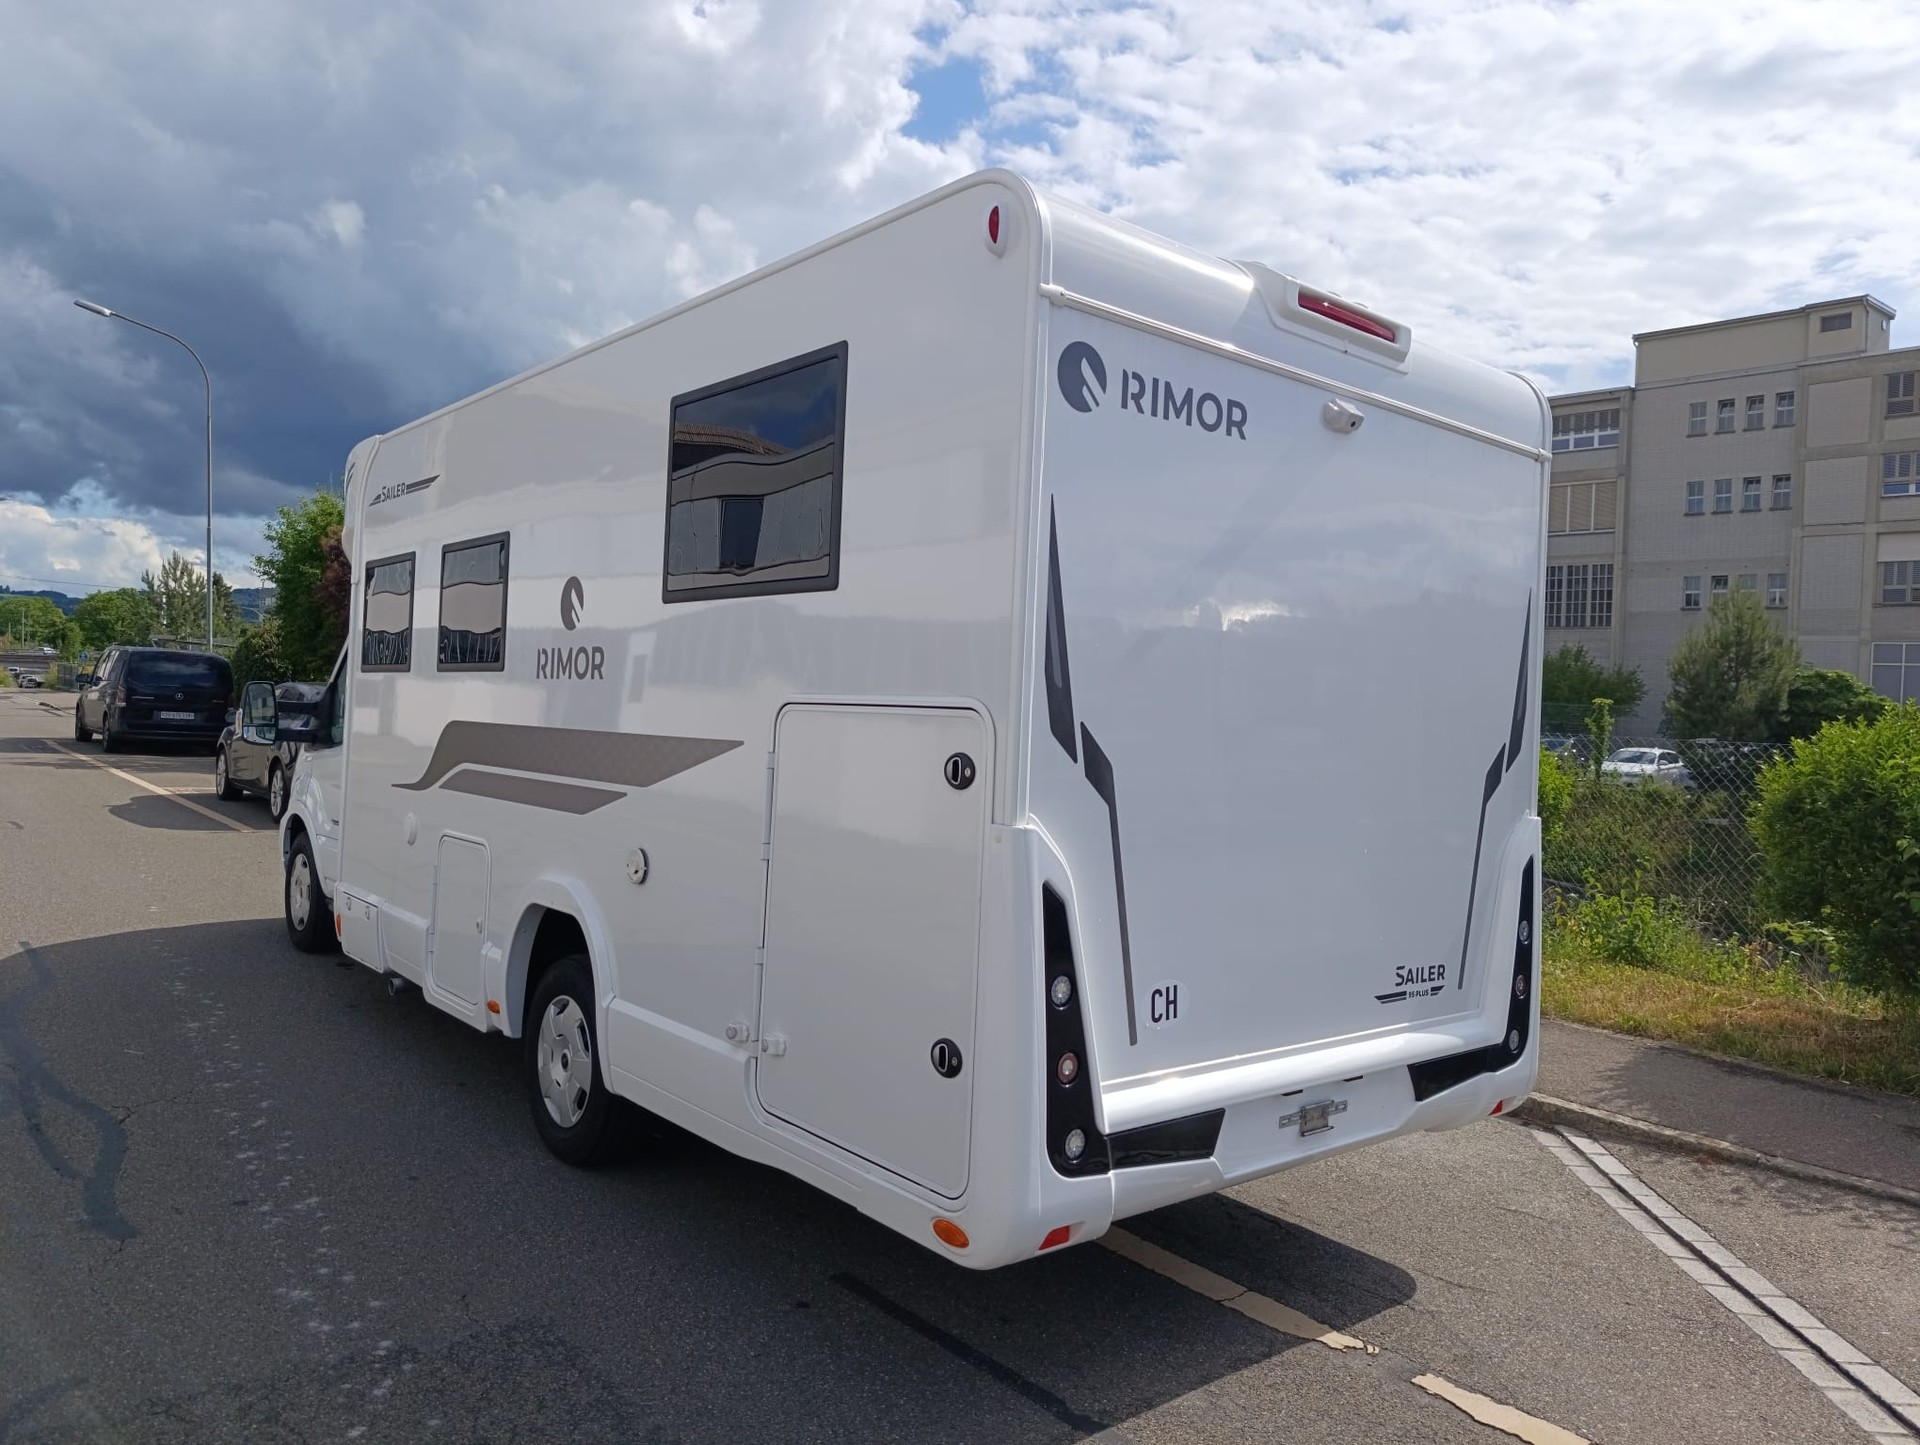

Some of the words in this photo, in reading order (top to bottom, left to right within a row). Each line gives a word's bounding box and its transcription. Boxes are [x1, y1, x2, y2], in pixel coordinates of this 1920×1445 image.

[1121, 368, 1248, 440] RIMOR
[381, 482, 406, 502] SAILER
[536, 646, 604, 680] RIMOR
[1395, 964, 1446, 987] SAILER
[1151, 984, 1178, 1023] CH
[1416, 989, 1429, 997] PLUS
